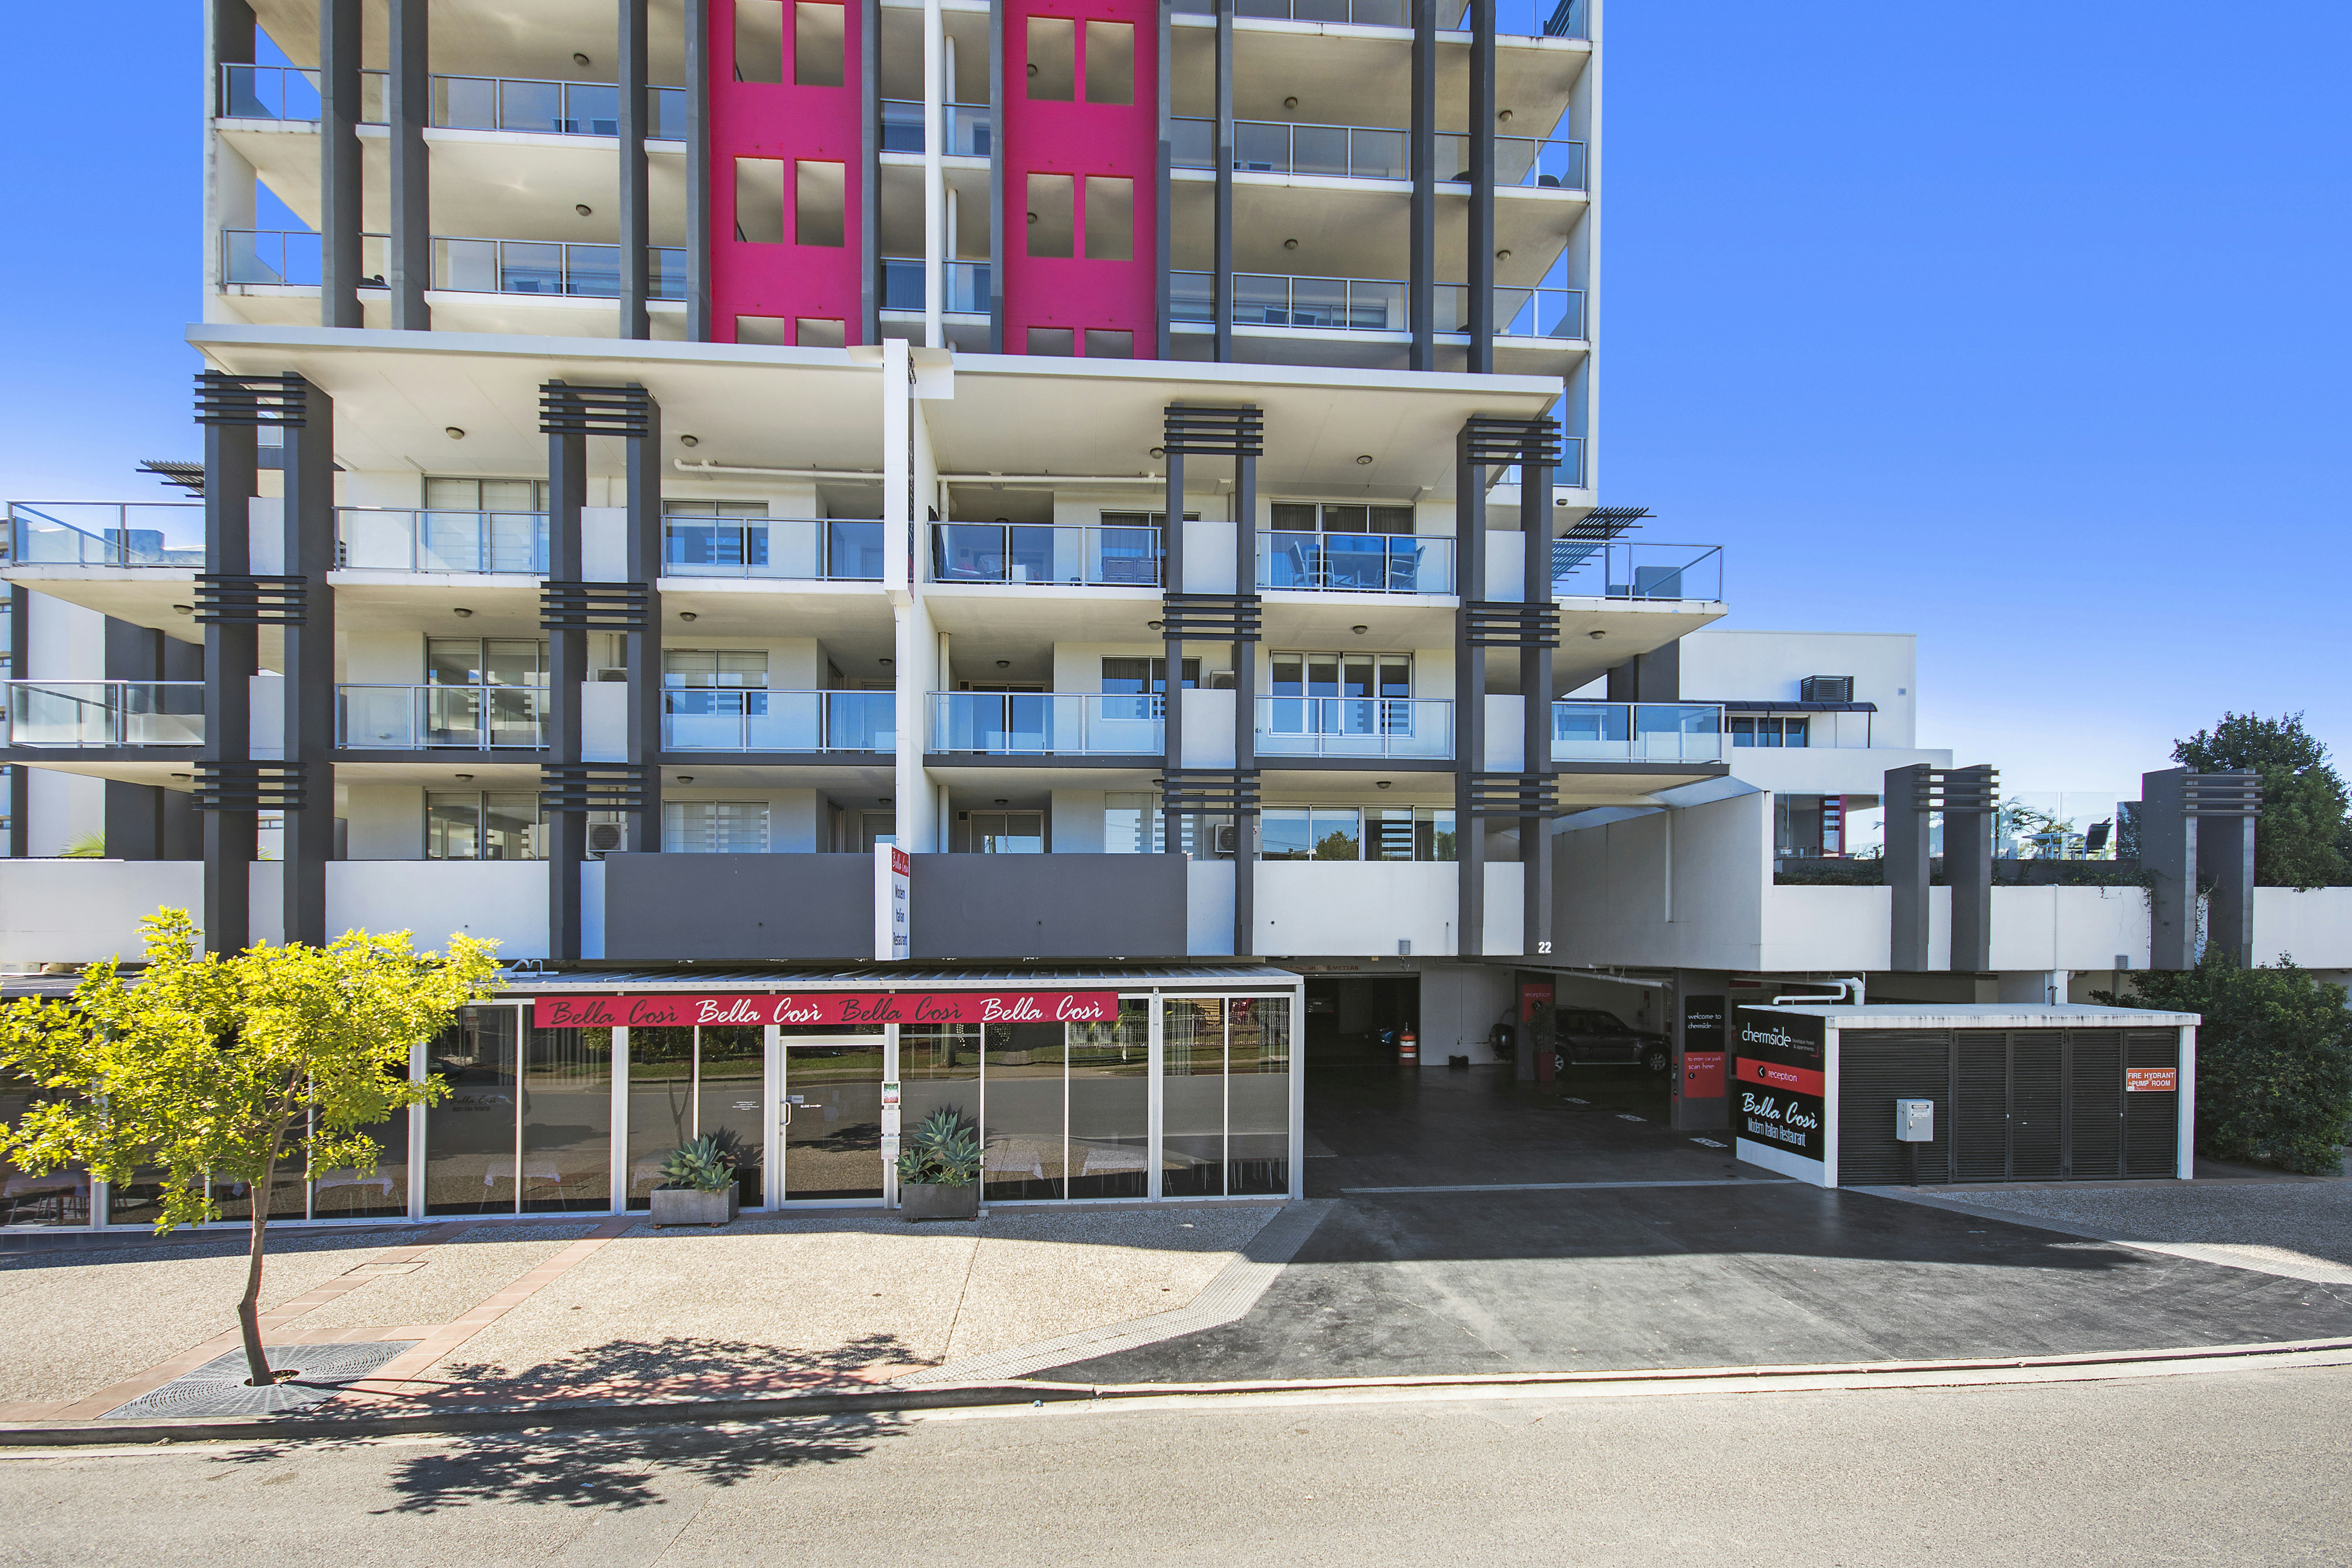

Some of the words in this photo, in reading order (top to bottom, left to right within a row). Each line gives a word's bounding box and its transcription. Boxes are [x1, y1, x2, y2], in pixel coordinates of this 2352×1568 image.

[895, 884, 905, 900] Modern
[896, 908, 904, 922] Italian
[893, 931, 907, 946] Restaurant
[1538, 942, 1552, 953] 22
[549, 1001, 615, 1024] Bella
[628, 999, 678, 1024] Così
[695, 999, 760, 1023] Bella
[773, 997, 822, 1023] Così
[839, 998, 902, 1021] Bella
[915, 996, 962, 1021] Così
[980, 997, 1043, 1021] Bella
[1056, 995, 1103, 1020] Così
[1742, 1022, 1791, 1047] chermside
[1769, 1071, 1797, 1082] reception
[1742, 1093, 1781, 1119] Bella
[1786, 1102, 1817, 1129] Così
[1748, 1117, 1764, 1135] Modern
[1765, 1121, 1779, 1139] Italian
[1780, 1125, 1806, 1147] Restaurant
